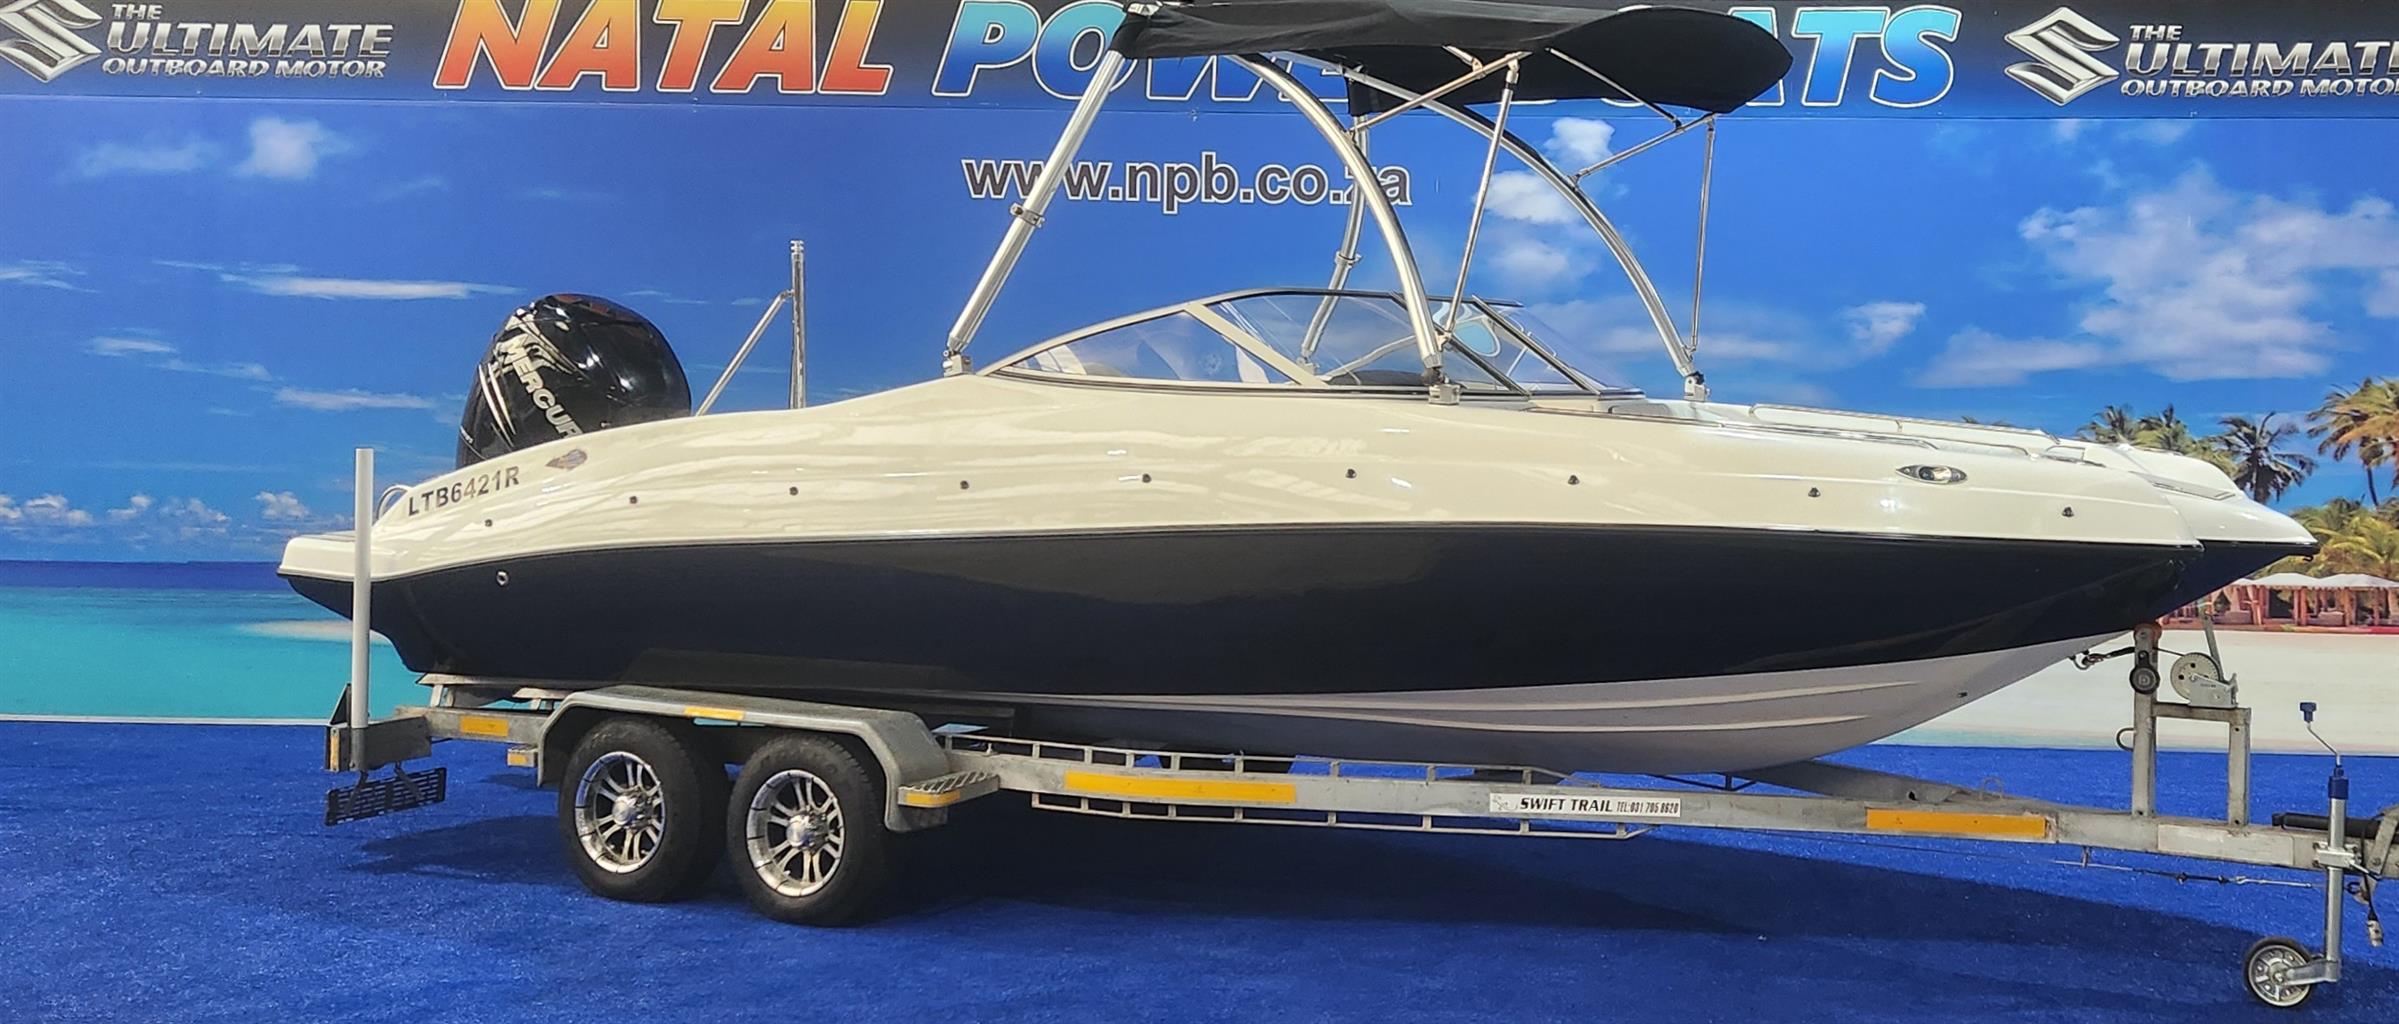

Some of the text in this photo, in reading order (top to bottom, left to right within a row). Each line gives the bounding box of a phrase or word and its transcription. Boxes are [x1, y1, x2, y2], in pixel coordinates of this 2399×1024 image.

[110, 3, 162, 20] THE
[105, 21, 394, 58] ULTIMATE
[2128, 24, 2183, 42] THE
[432, 0, 894, 94] NATAL
[102, 58, 387, 78] OUTBOARD MOTOR
[2120, 78, 2399, 98] OUTBOARD MOTO
[494, 332, 584, 438] MERCUR
[408, 466, 520, 516] LTB6421R
[1520, 797, 1566, 811] SWIFT
[1570, 798, 1613, 812] TRAIL
